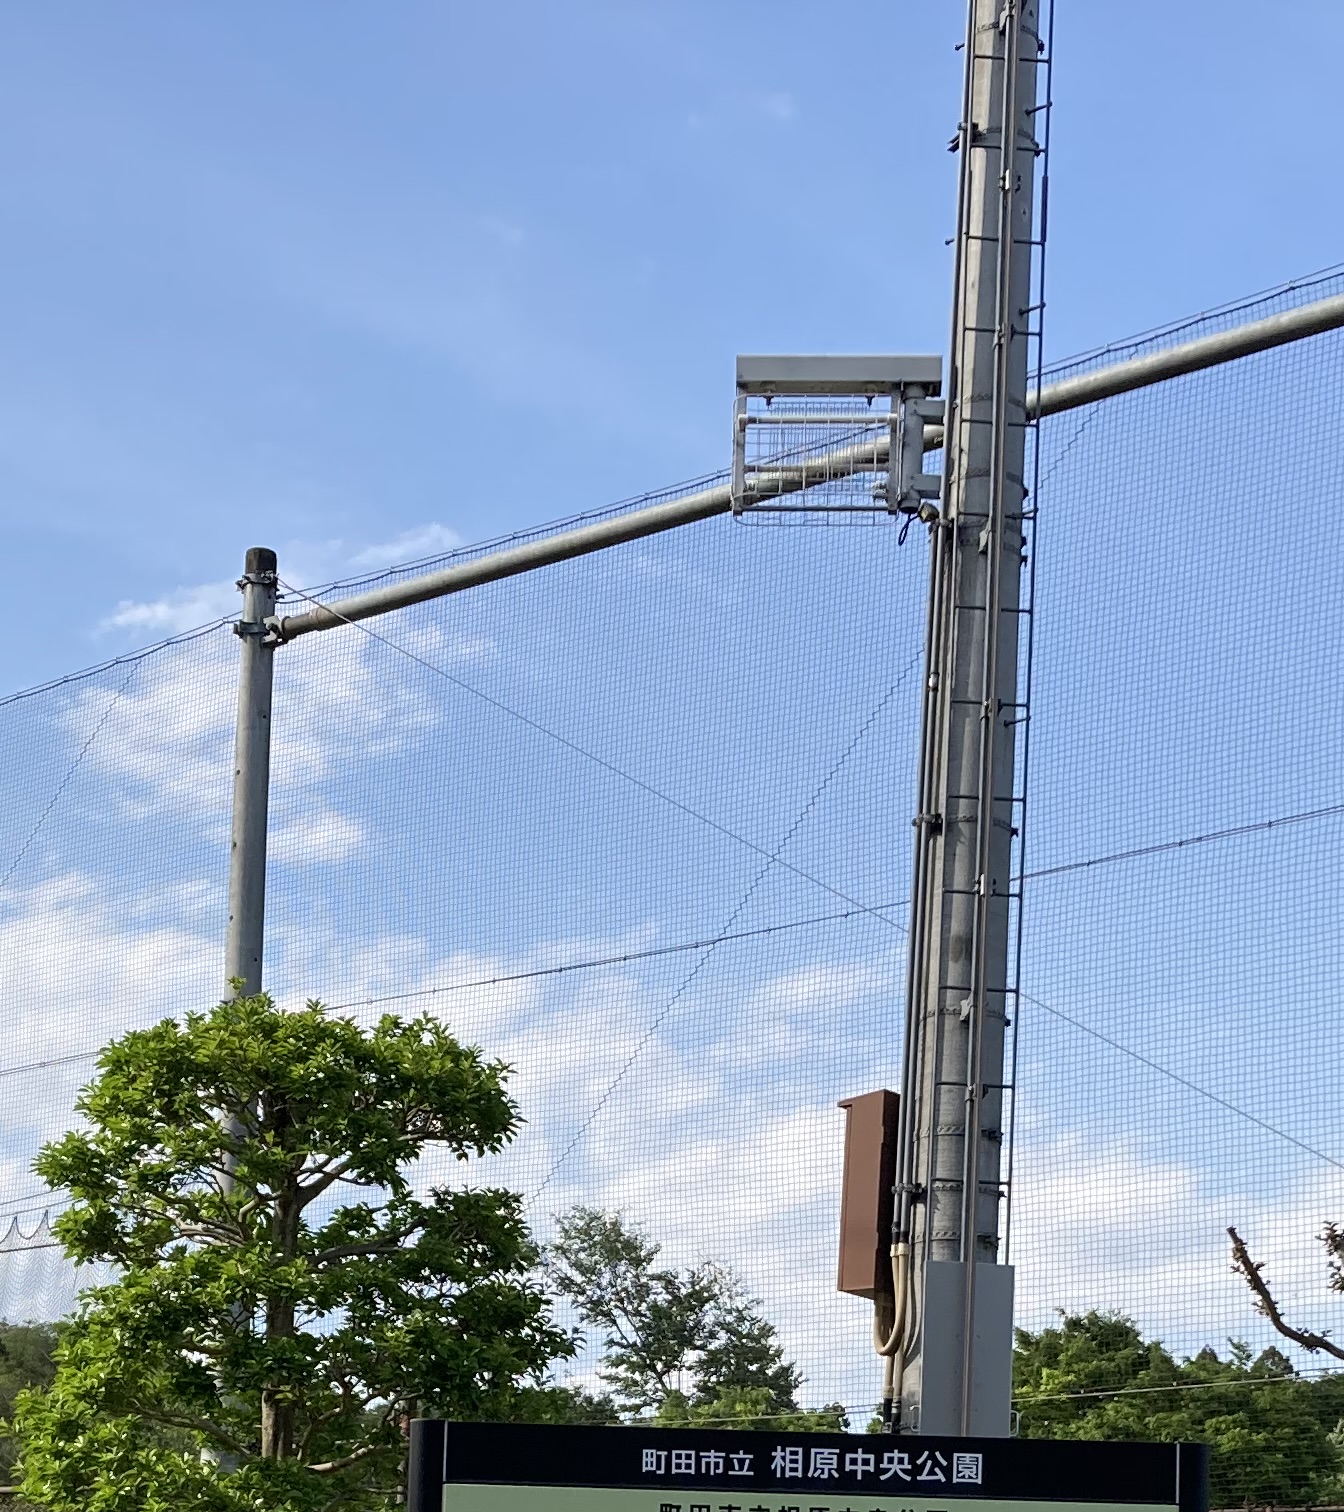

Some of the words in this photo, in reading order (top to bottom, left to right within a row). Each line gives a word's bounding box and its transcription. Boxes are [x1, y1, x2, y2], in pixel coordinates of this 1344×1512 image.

[641, 1448, 755, 1476] 町田市立
[770, 1445, 983, 1485] 相原中央公園
